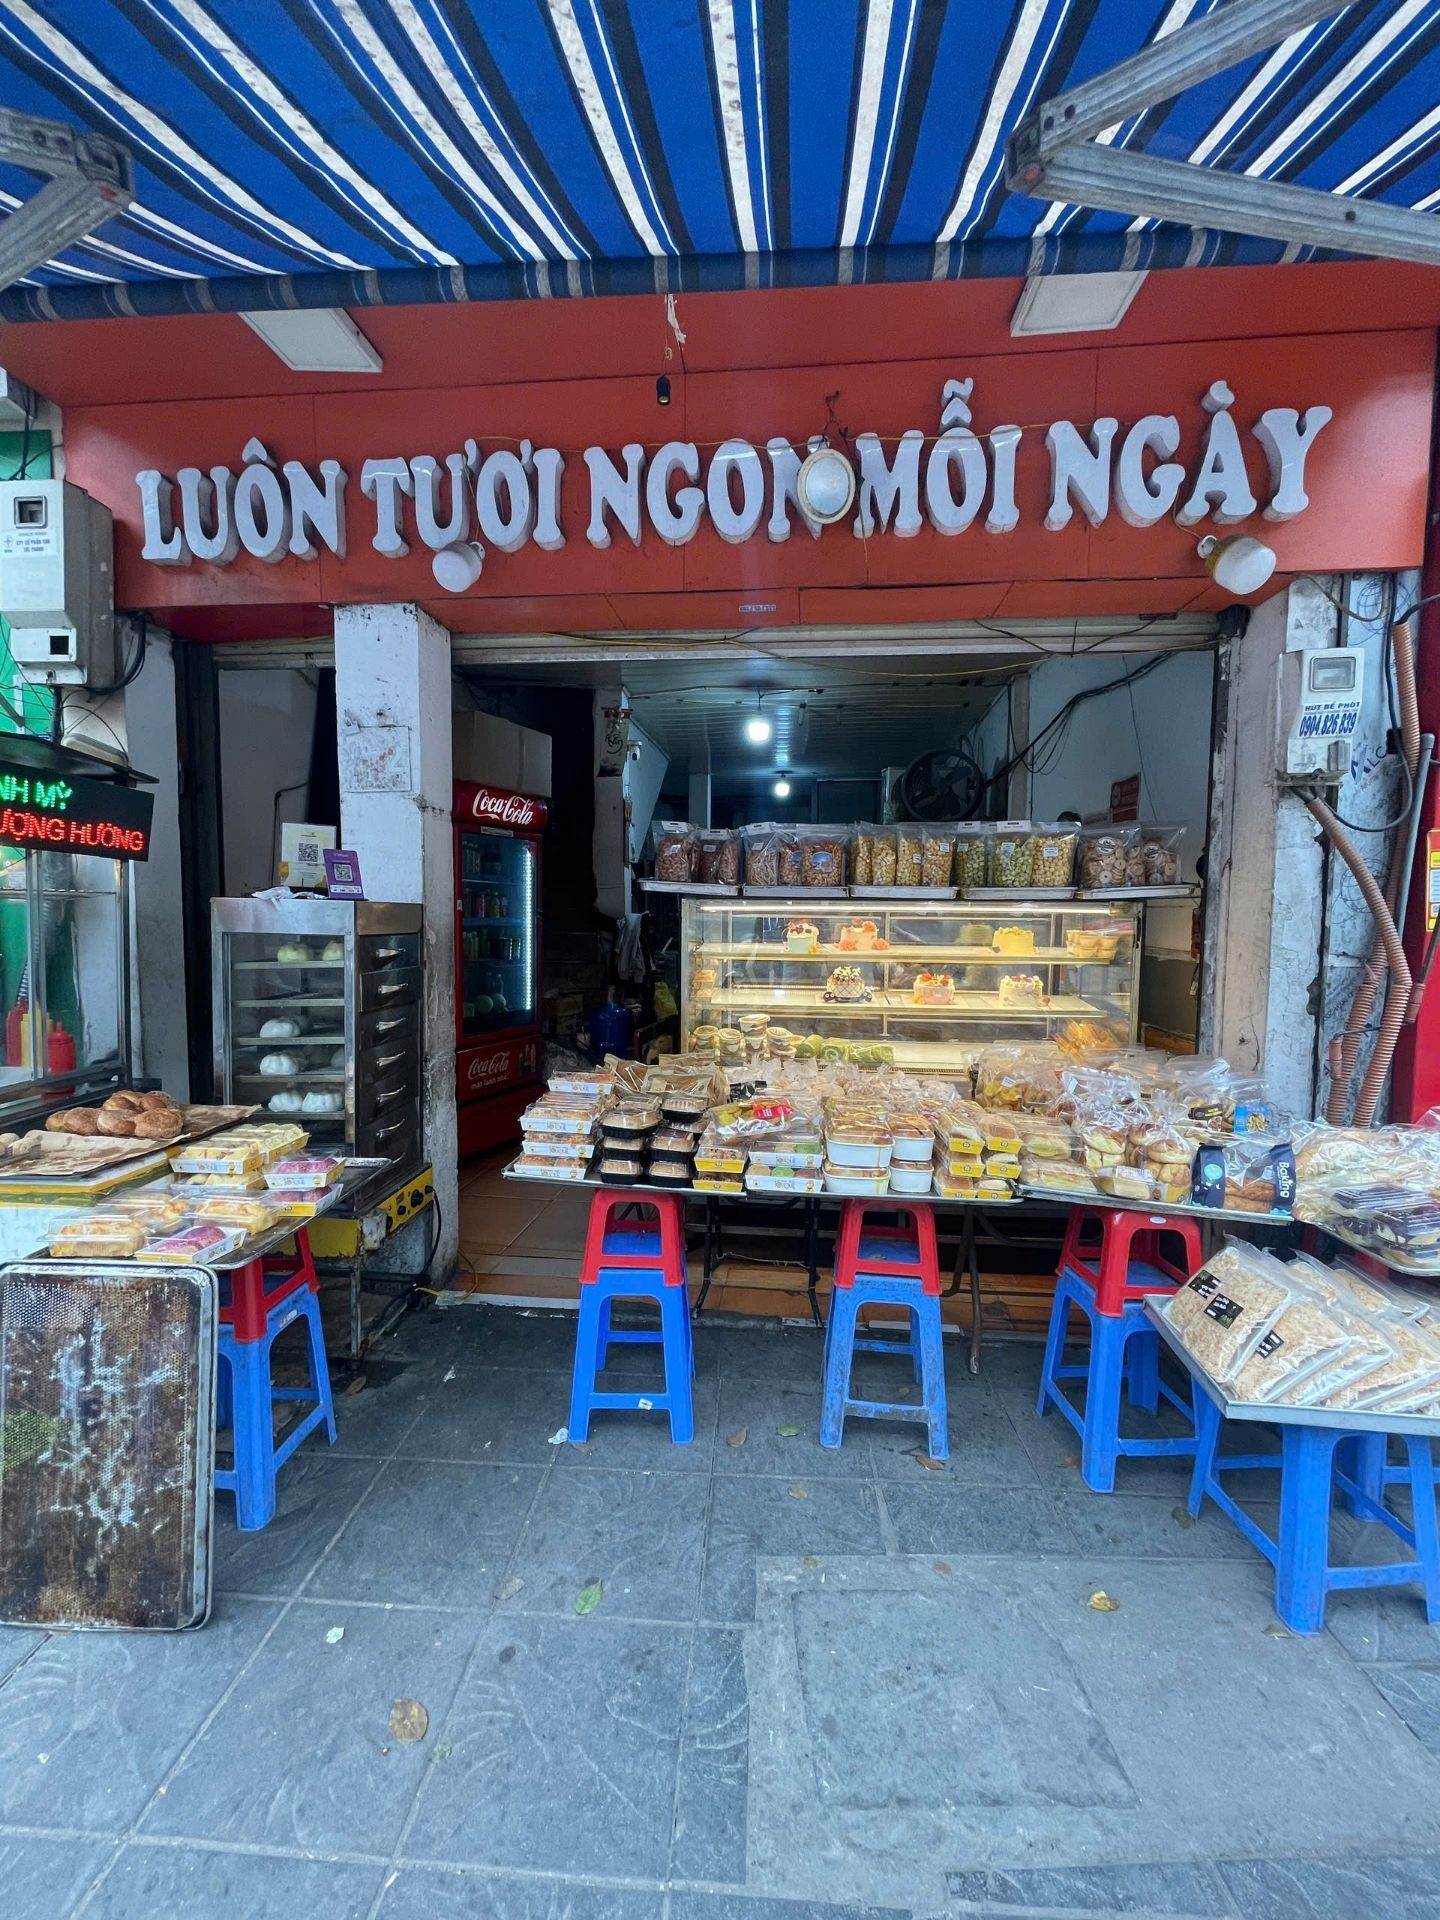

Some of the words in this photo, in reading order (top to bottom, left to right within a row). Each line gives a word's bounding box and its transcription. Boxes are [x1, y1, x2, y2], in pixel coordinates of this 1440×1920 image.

[136, 437, 348, 567] LUÔN
[360, 438, 567, 558] TƯƠI
[852, 377, 1022, 539] MỖI
[1043, 380, 1333, 529] NGÀY
[472, 789, 533, 825] Coca-Cola
[1278, 1162, 1292, 1198] Baking
